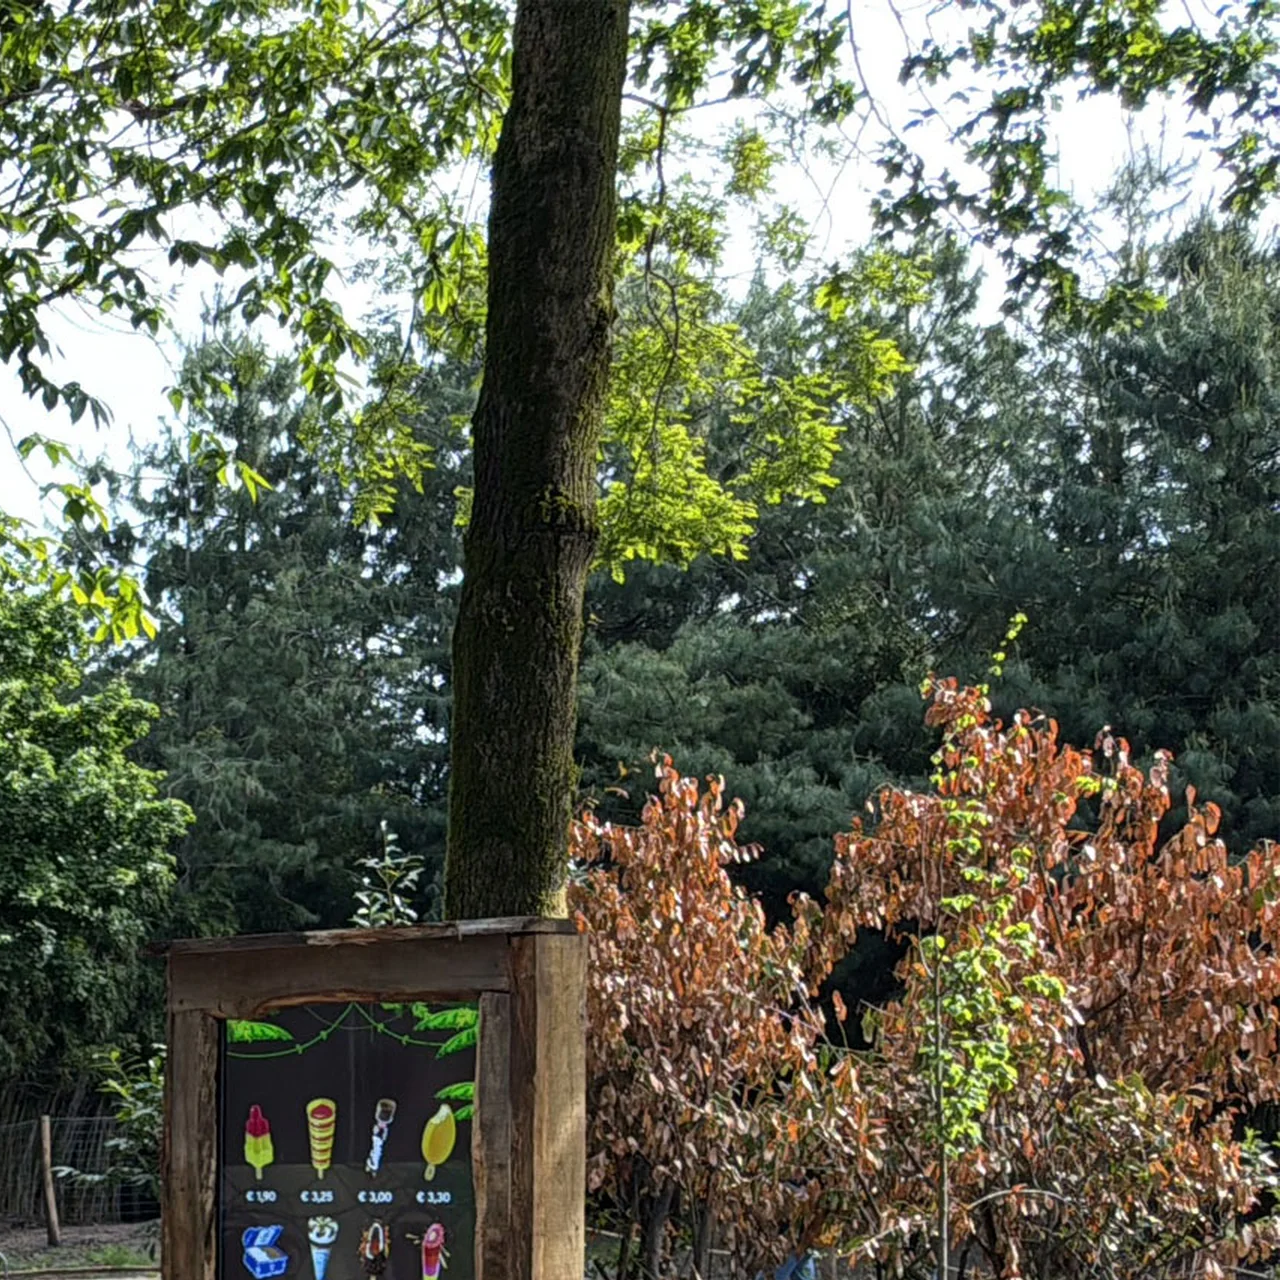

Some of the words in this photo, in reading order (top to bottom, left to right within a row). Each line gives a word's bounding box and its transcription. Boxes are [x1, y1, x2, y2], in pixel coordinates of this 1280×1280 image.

[246, 1191, 255, 1202] €
[256, 1191, 277, 1203] 1,90
[300, 1191, 310, 1203] €
[311, 1191, 333, 1204] 3,25
[358, 1191, 367, 1203] €
[369, 1191, 392, 1204] 3,00
[416, 1191, 425, 1204] €
